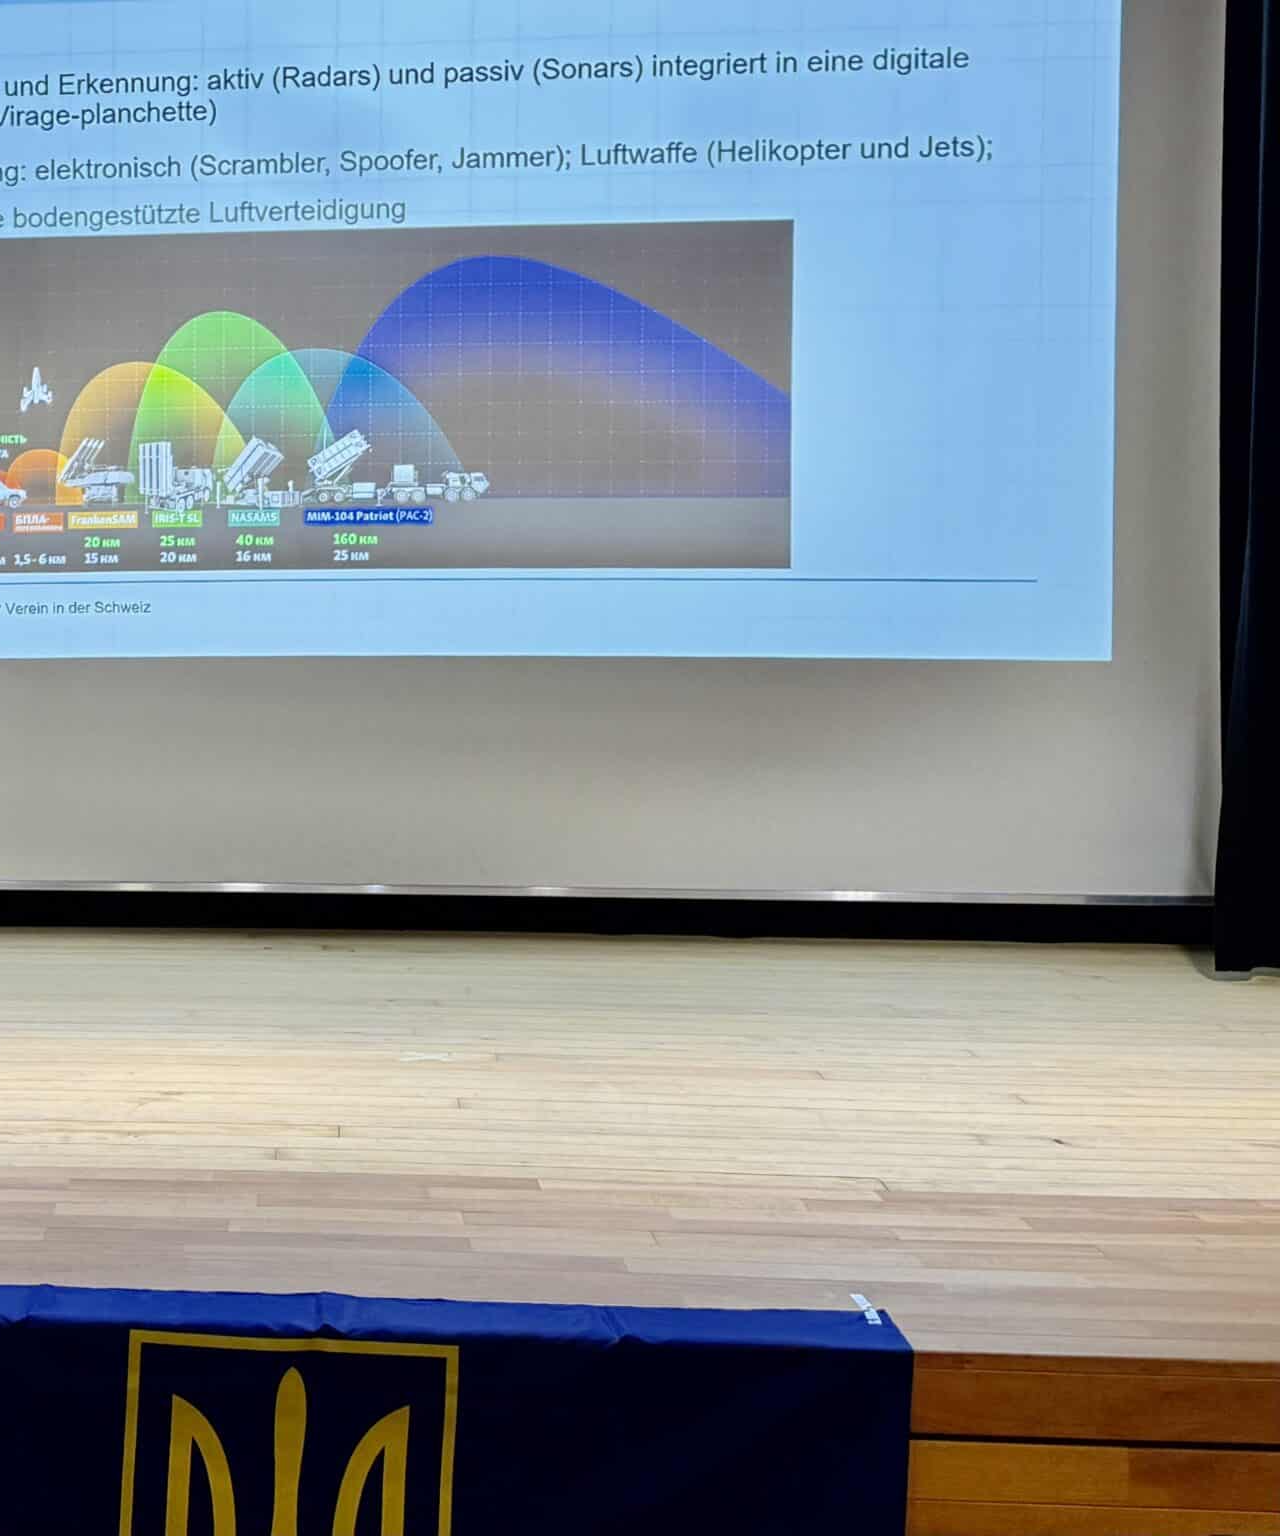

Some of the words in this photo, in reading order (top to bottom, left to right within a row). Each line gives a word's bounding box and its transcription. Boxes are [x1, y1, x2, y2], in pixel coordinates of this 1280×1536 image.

[5, 74, 48, 96] und
[59, 73, 198, 102] Erkennung:
[208, 67, 264, 90] aktiv
[273, 64, 380, 94] (Radars)
[389, 62, 434, 84] und
[445, 60, 524, 88] passiv
[533, 55, 643, 86] (Sonars)
[653, 52, 767, 80] integriert
[776, 51, 797, 73] in
[808, 50, 863, 72] eine
[873, 46, 969, 75] digitale
[35, 156, 180, 180] elektronisch
[191, 152, 330, 182] (Scrambler,
[340, 149, 442, 176] Spoofer,
[452, 145, 571, 171] Jammer);
[582, 142, 697, 165] Luftwaffe
[708, 139, 852, 168] (Helikopter
[861, 136, 909, 159] und
[919, 135, 992, 162] Jets);
[13, 203, 203, 234] bodengestützte
[210, 198, 405, 225] Luftverteidigung
[307, 512, 354, 521] MIM-104
[357, 511, 394, 521] Patriot
[396, 510, 433, 522] (PAC-2)
[84, 537, 100, 548] 20
[160, 536, 176, 546] 25
[236, 535, 253, 545] 40
[334, 534, 357, 544] 160
[84, 553, 98, 563] 15
[160, 552, 176, 562] 20
[236, 551, 251, 561] 16
[334, 550, 348, 561] 25
[5, 602, 48, 615] Verein
[53, 602, 64, 615] in
[68, 601, 90, 615] der
[95, 600, 152, 614] Schweiz
